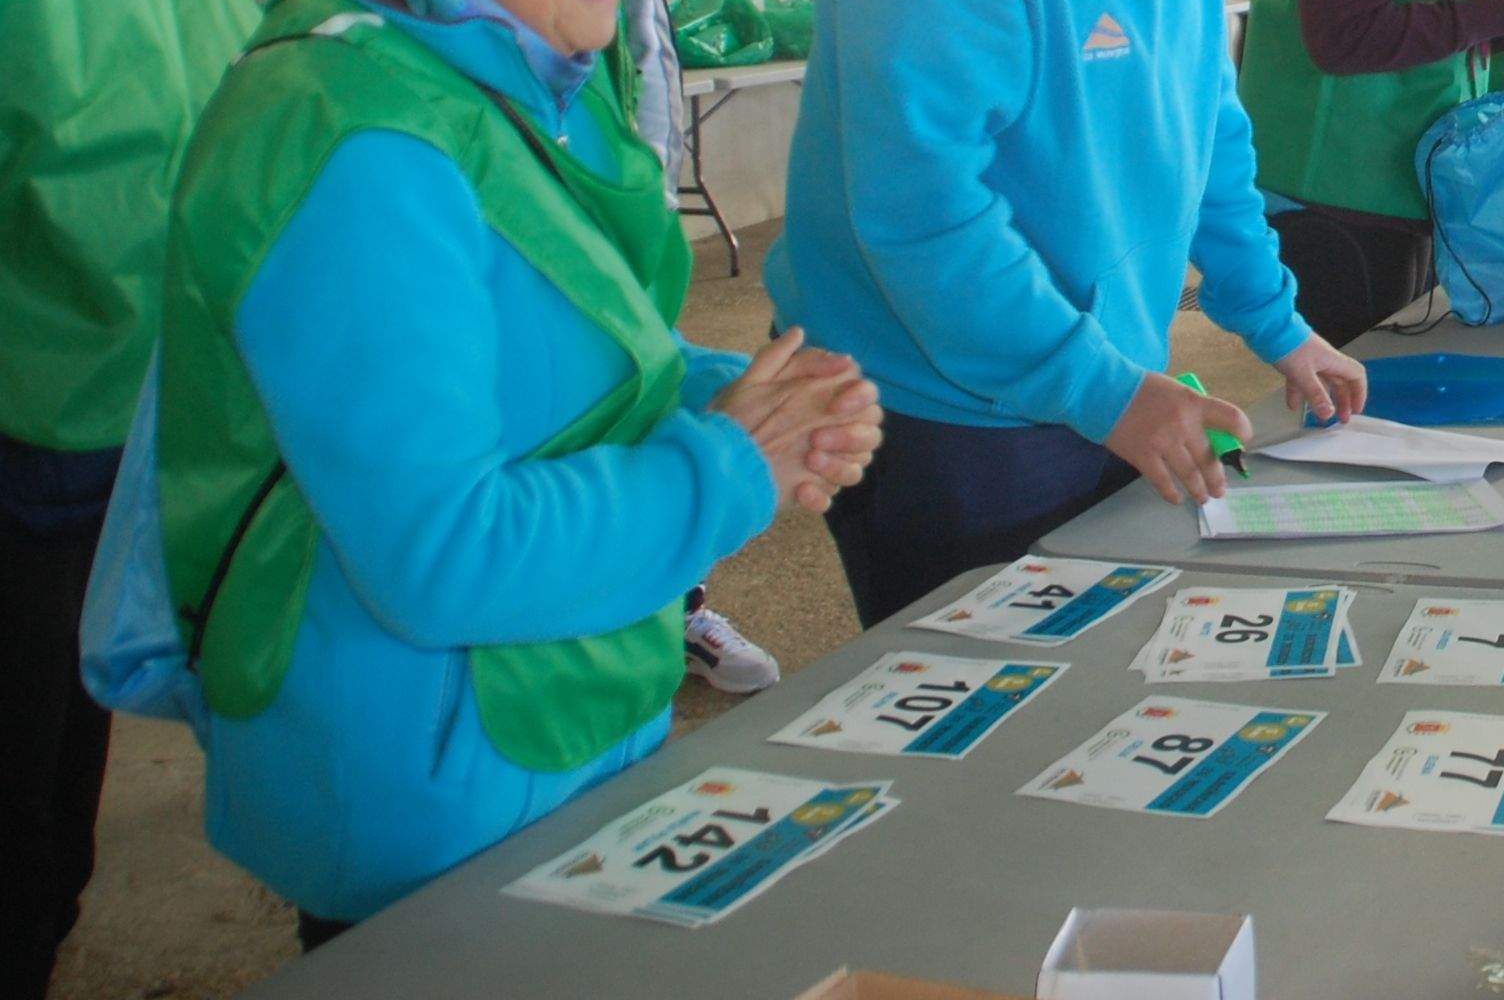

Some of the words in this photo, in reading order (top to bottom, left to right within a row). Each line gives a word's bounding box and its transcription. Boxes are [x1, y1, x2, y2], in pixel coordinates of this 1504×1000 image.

[1009, 584, 1075, 611] 41
[1215, 614, 1274, 644] 26
[876, 680, 971, 732] 107
[1132, 734, 1214, 775] 87
[633, 807, 771, 874] 142
